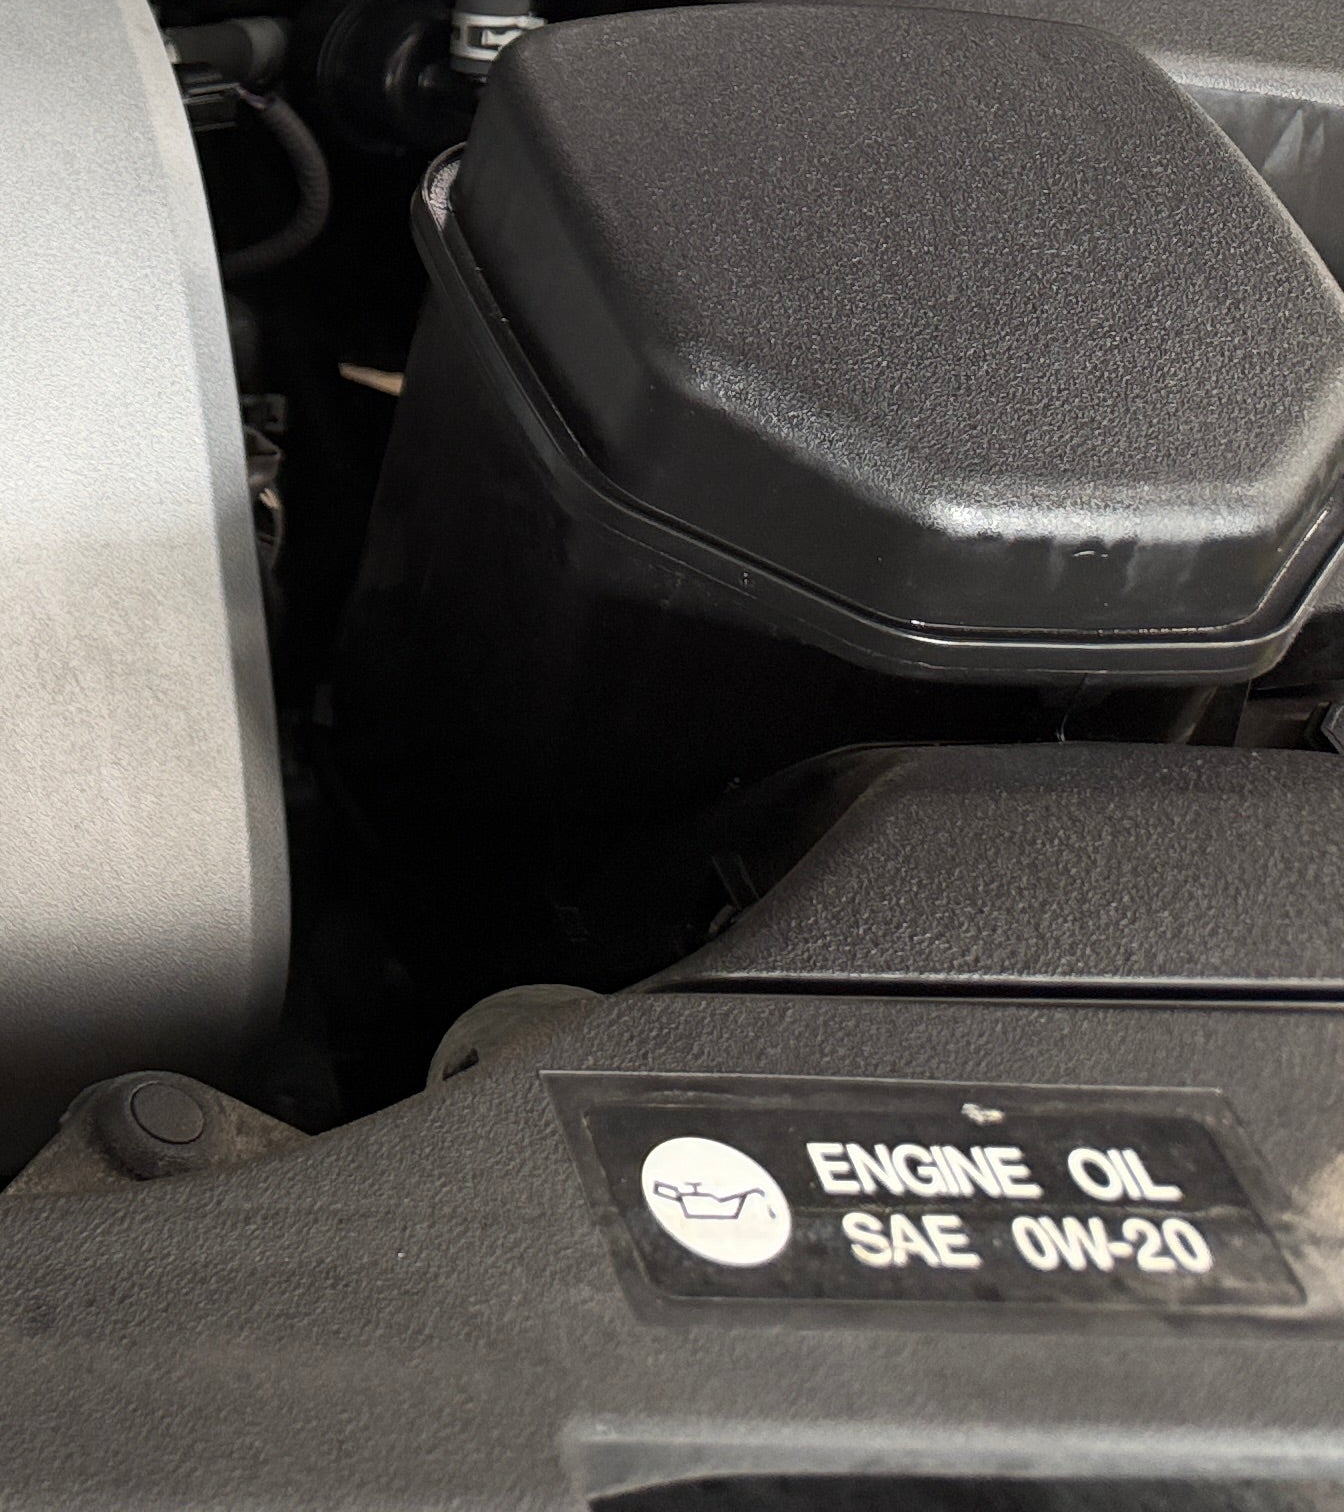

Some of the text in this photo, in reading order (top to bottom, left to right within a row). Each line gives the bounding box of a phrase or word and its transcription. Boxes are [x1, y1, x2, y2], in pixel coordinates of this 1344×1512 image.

[806, 1142, 1183, 1201] ENGINE OIL
[842, 1212, 1214, 1272] SAE 0W-20
